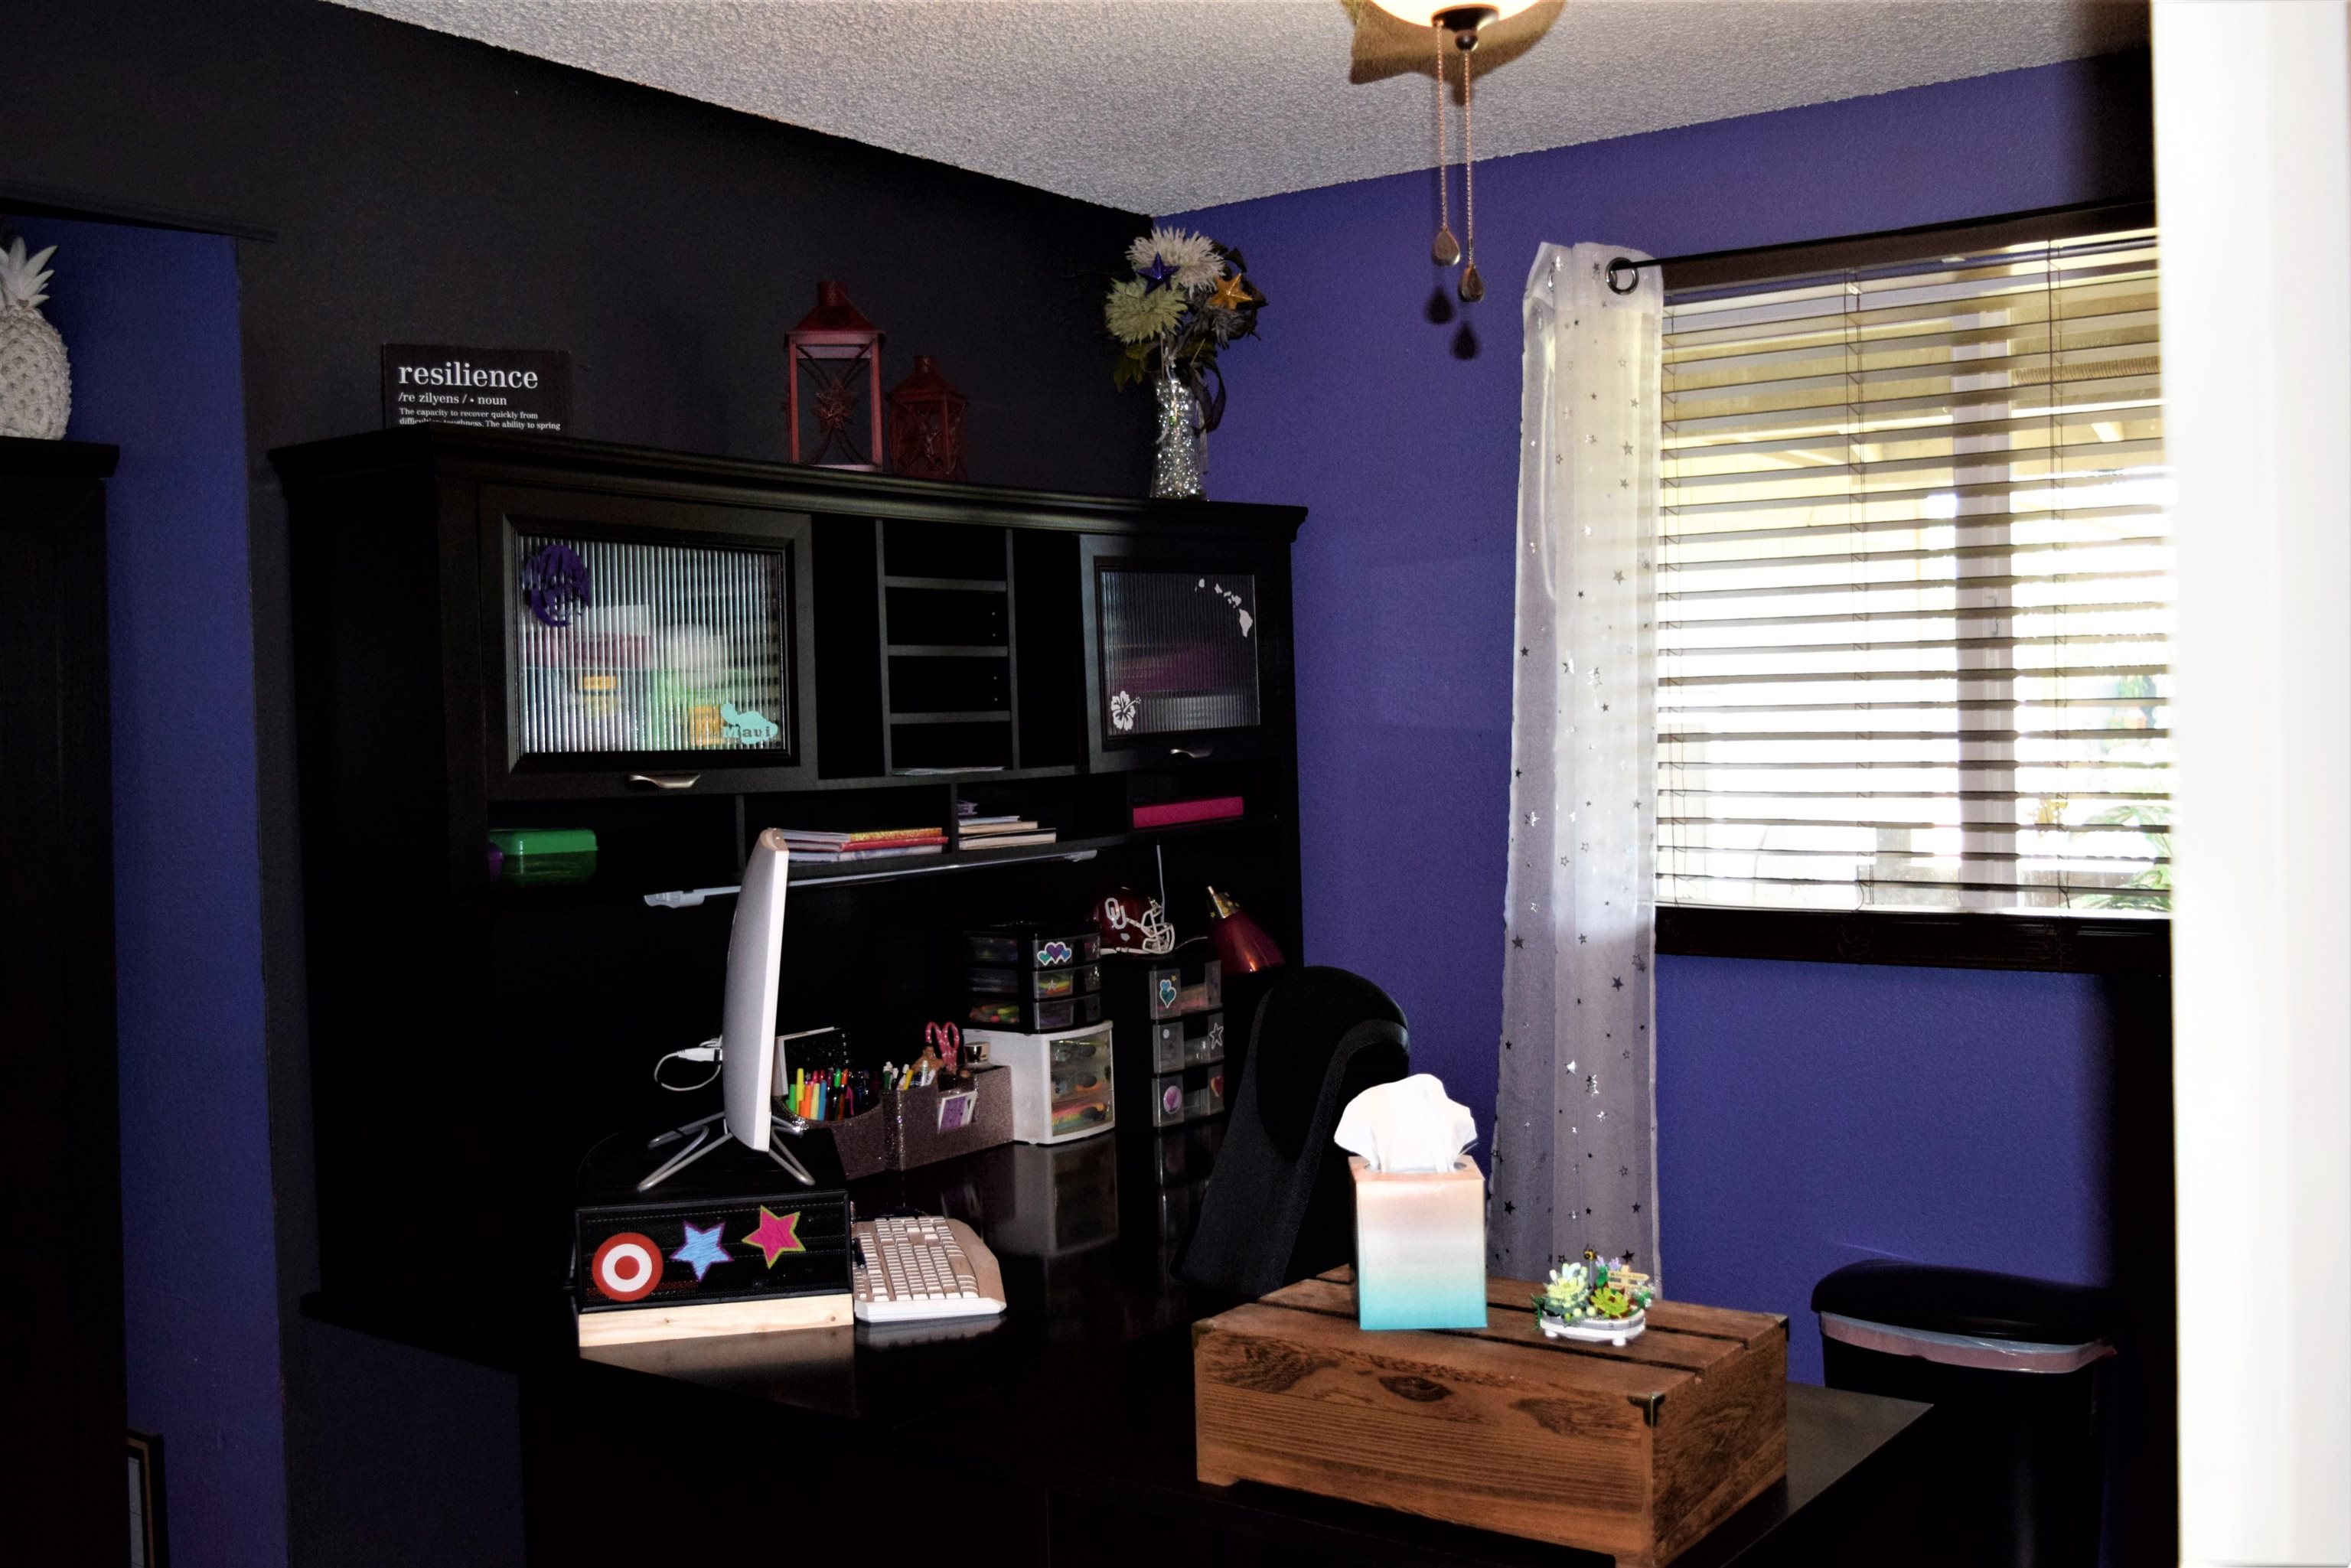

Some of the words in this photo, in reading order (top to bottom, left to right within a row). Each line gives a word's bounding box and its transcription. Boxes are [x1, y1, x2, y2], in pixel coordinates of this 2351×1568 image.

[398, 361, 539, 390] resilience
[398, 392, 416, 403] /re
[419, 393, 460, 406] zilyens
[478, 396, 507, 406] noun
[399, 408, 415, 416] The
[416, 409, 448, 419] capacity
[491, 411, 518, 421] quickly
[520, 412, 539, 420] from
[485, 419, 501, 428] The
[502, 420, 526, 430] ability
[536, 422, 561, 432] spring
[723, 725, 771, 738] Maui
[1104, 897, 1127, 930] OU
